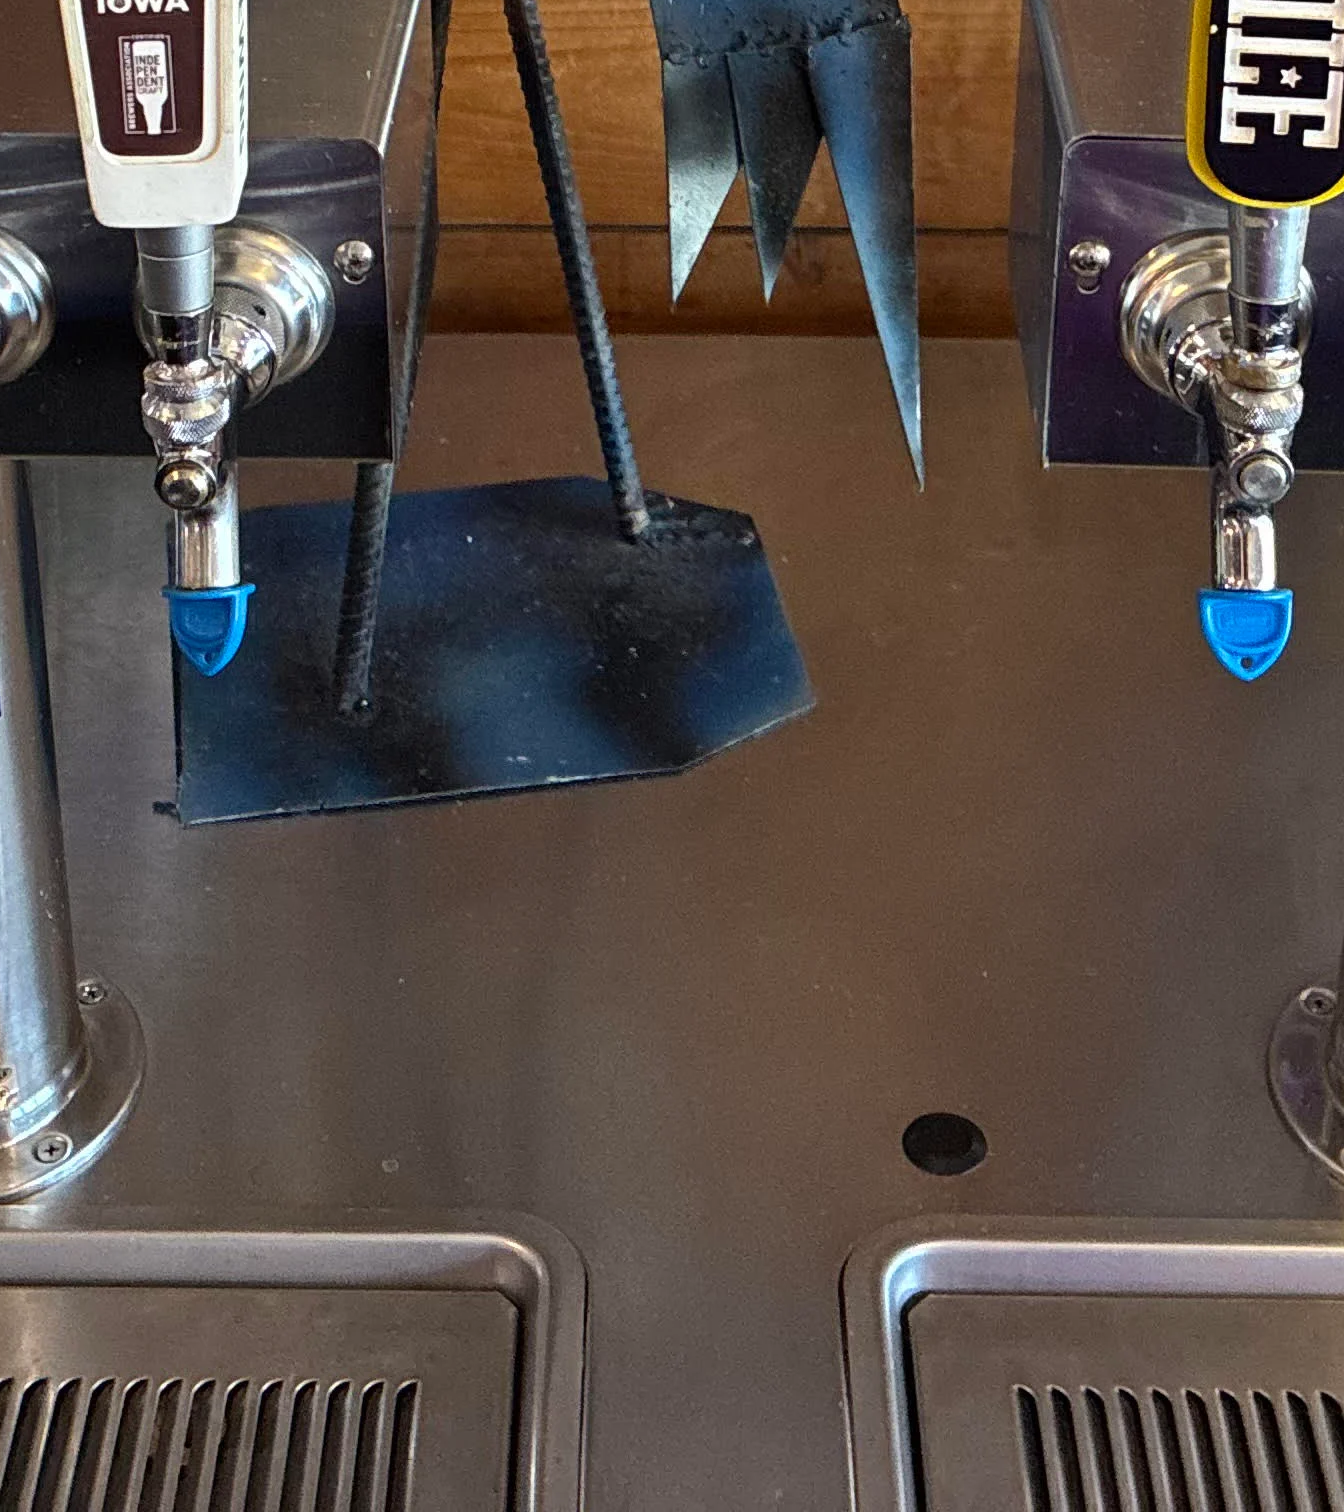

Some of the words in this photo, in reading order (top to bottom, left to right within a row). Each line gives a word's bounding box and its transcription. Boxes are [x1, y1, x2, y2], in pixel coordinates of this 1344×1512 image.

[135, 54, 160, 65] INDE
[136, 66, 158, 76] PEN
[137, 76, 164, 87] DENT
